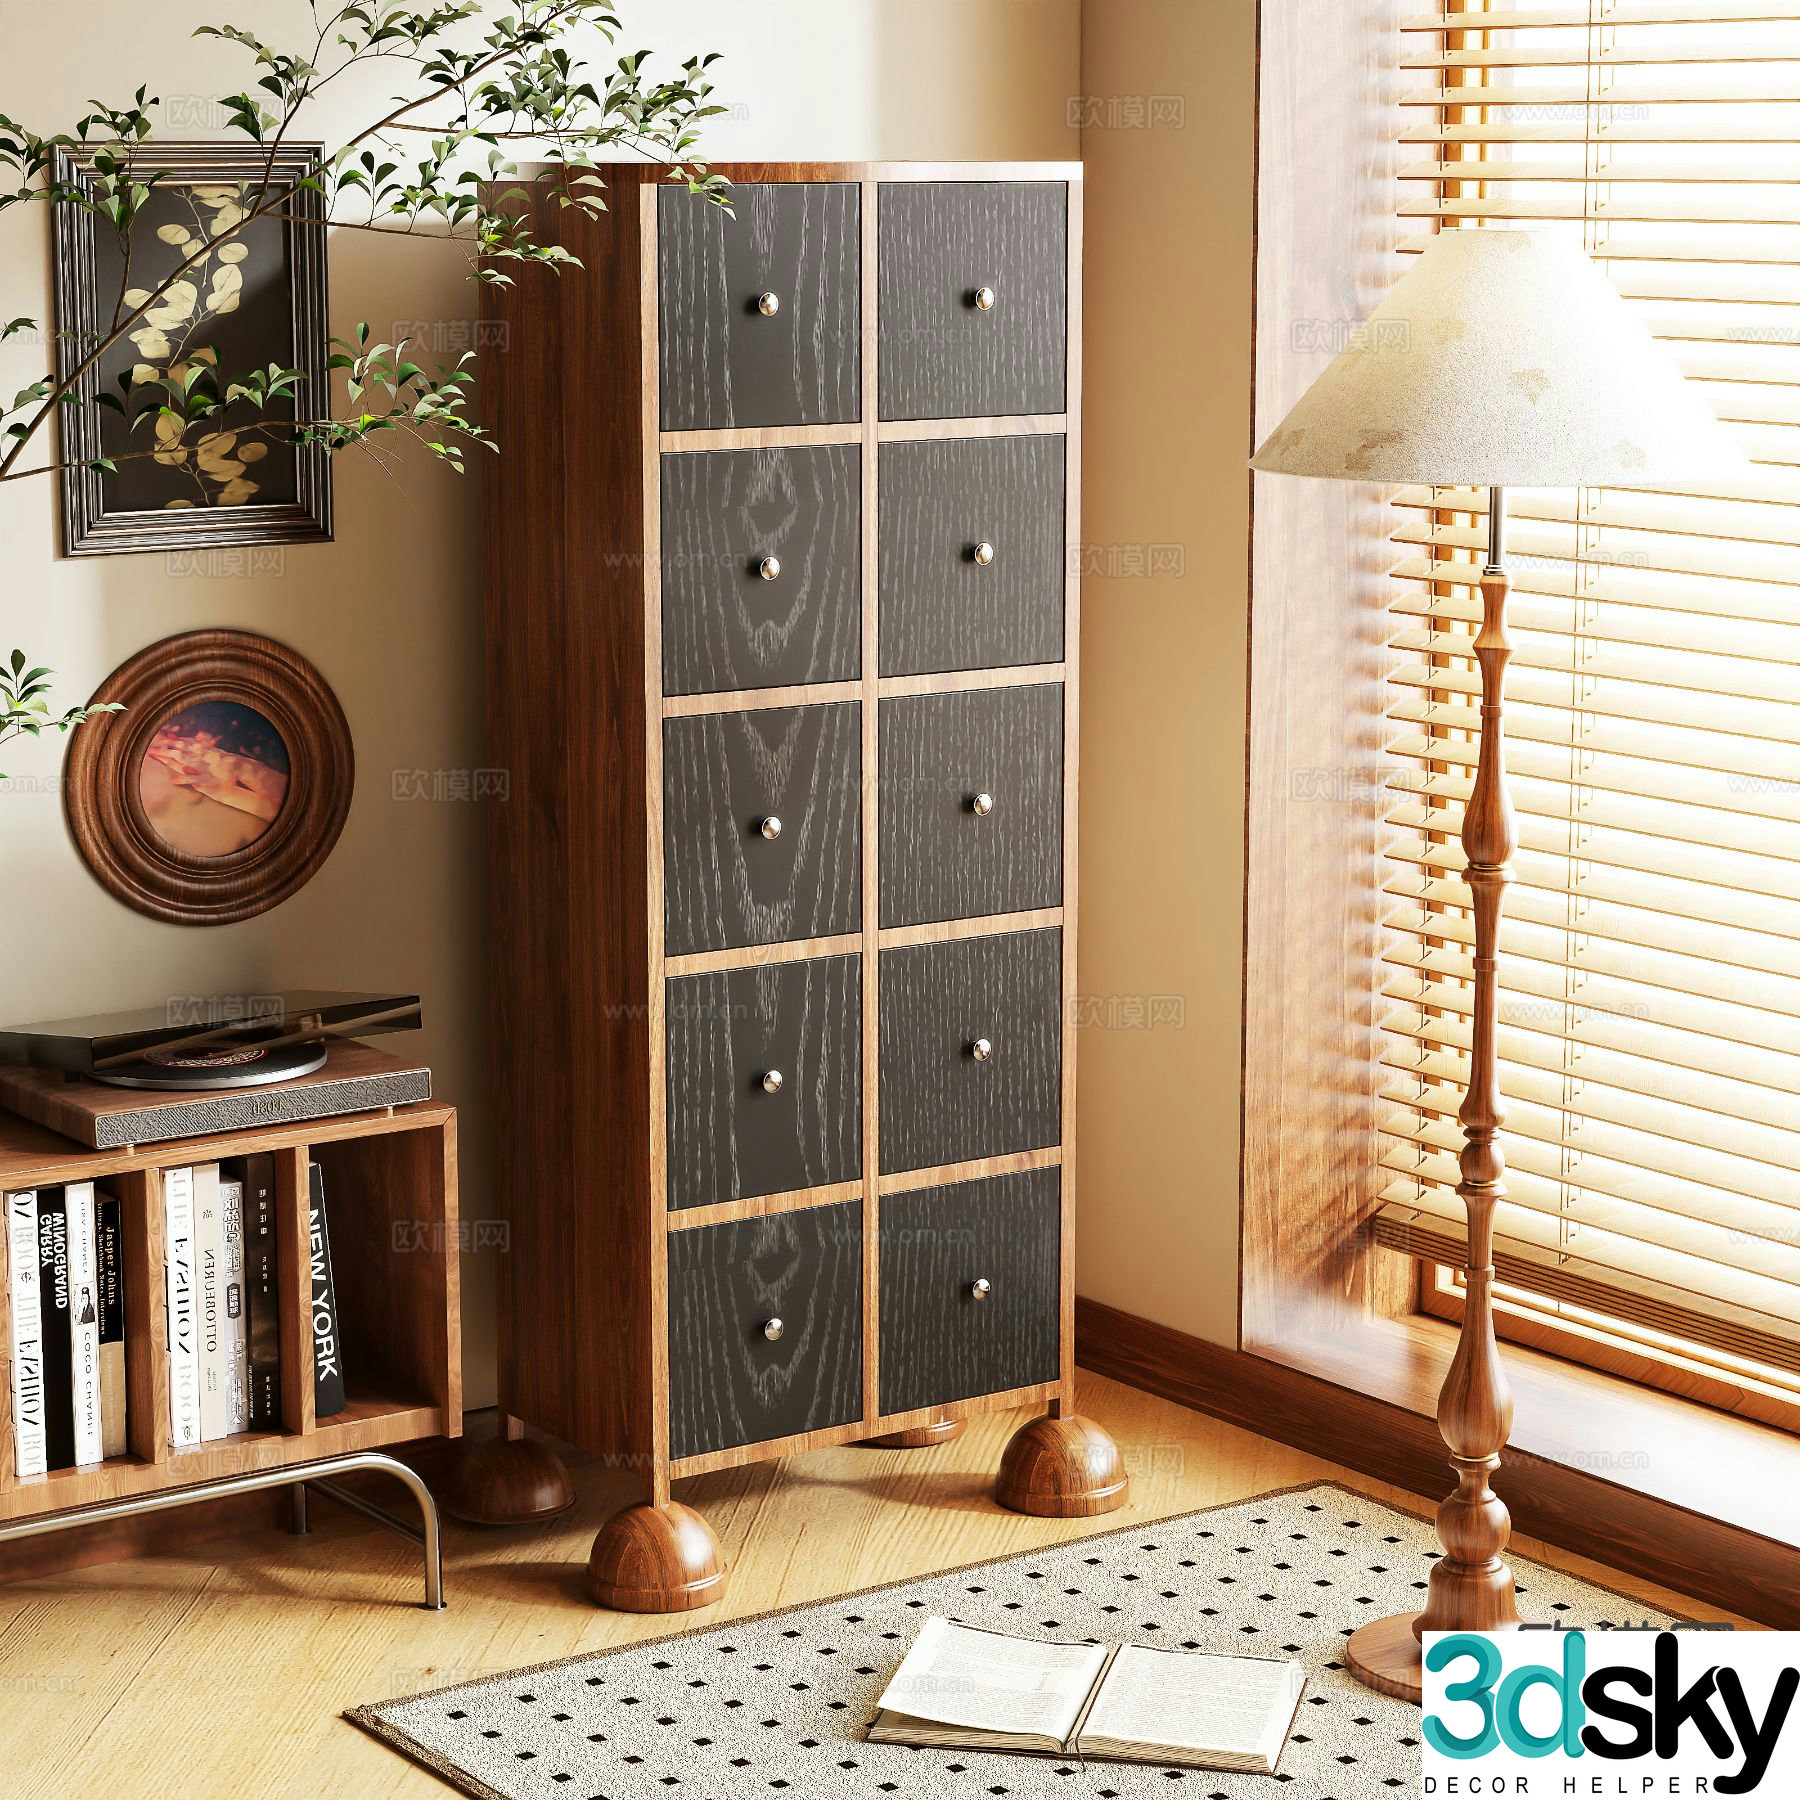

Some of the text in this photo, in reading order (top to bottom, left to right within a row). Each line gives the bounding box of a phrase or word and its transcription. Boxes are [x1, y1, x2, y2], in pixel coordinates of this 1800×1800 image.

[104, 1226, 117, 1306] Jasper Johns
[309, 1208, 338, 1382] NEW YORK
